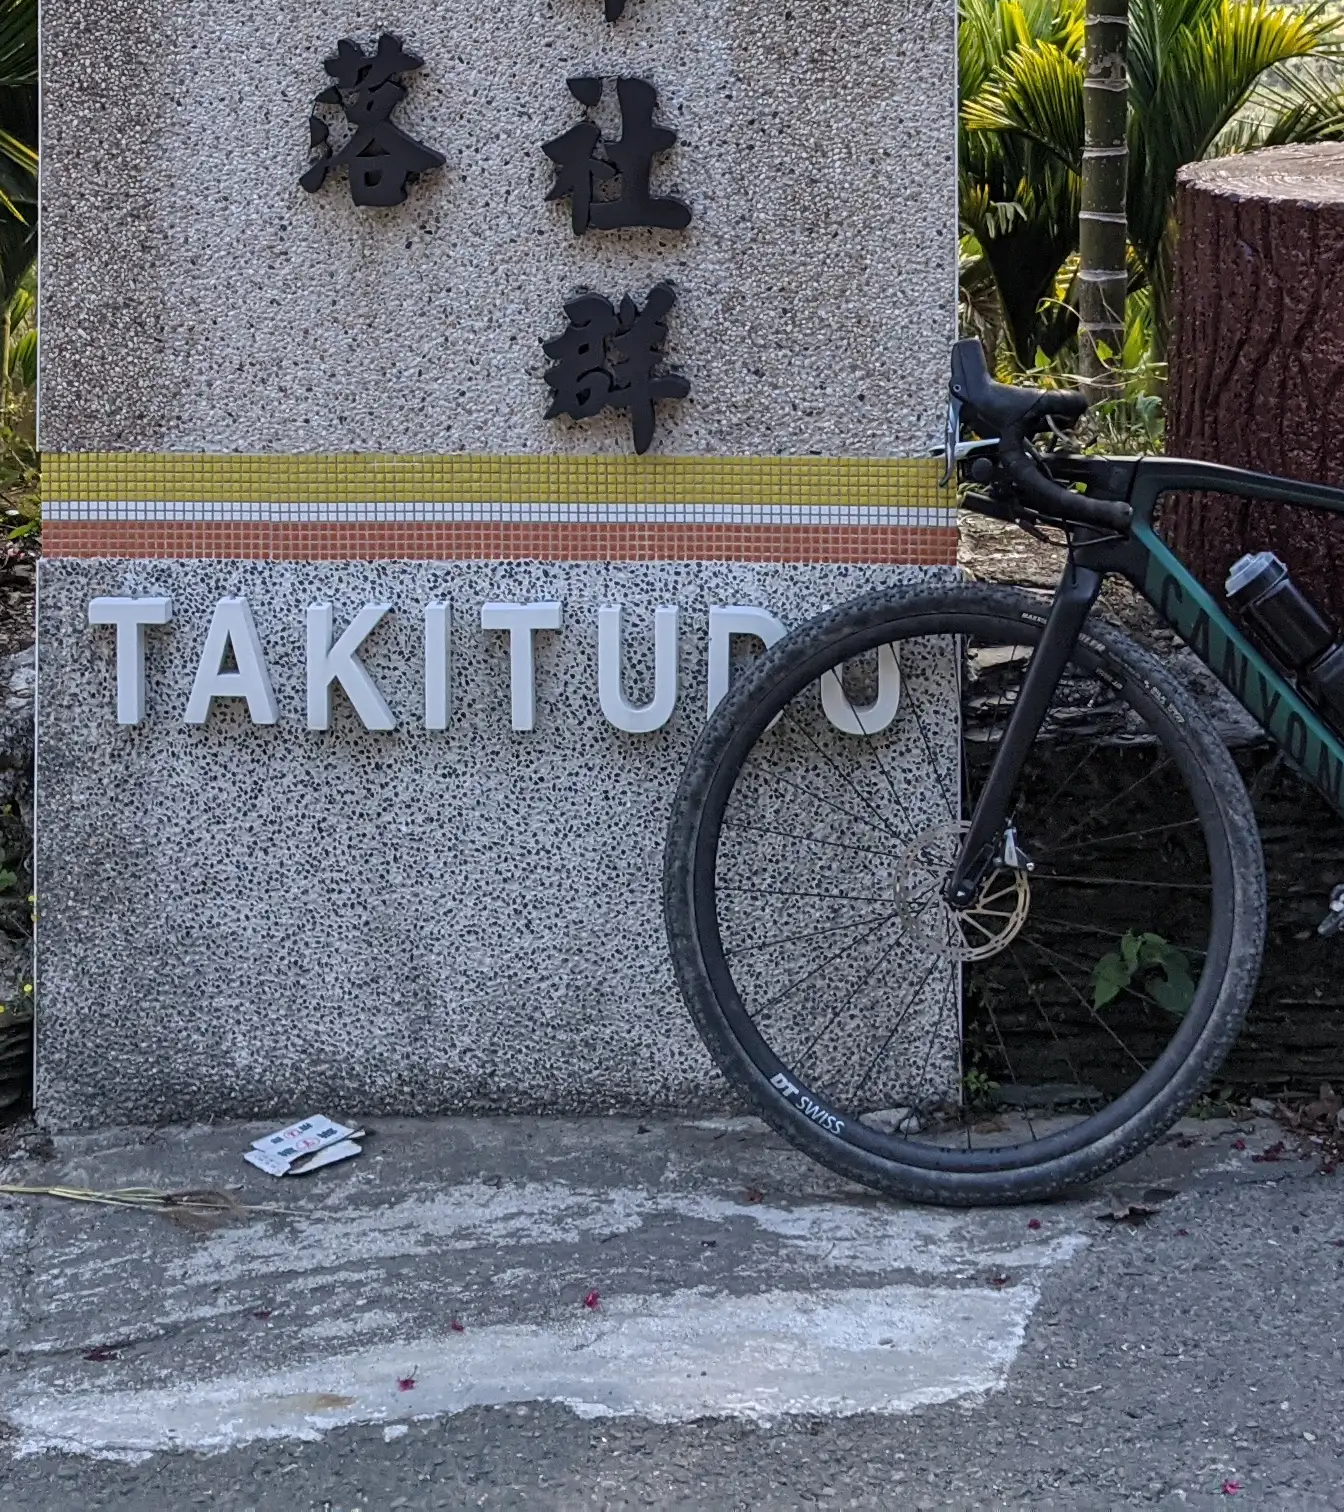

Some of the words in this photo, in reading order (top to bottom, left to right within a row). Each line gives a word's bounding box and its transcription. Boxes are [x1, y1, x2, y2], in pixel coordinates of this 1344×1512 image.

[1161, 573, 1344, 804] CANYON
[770, 1072, 800, 1097] DT
[795, 1095, 845, 1135] SWISS
